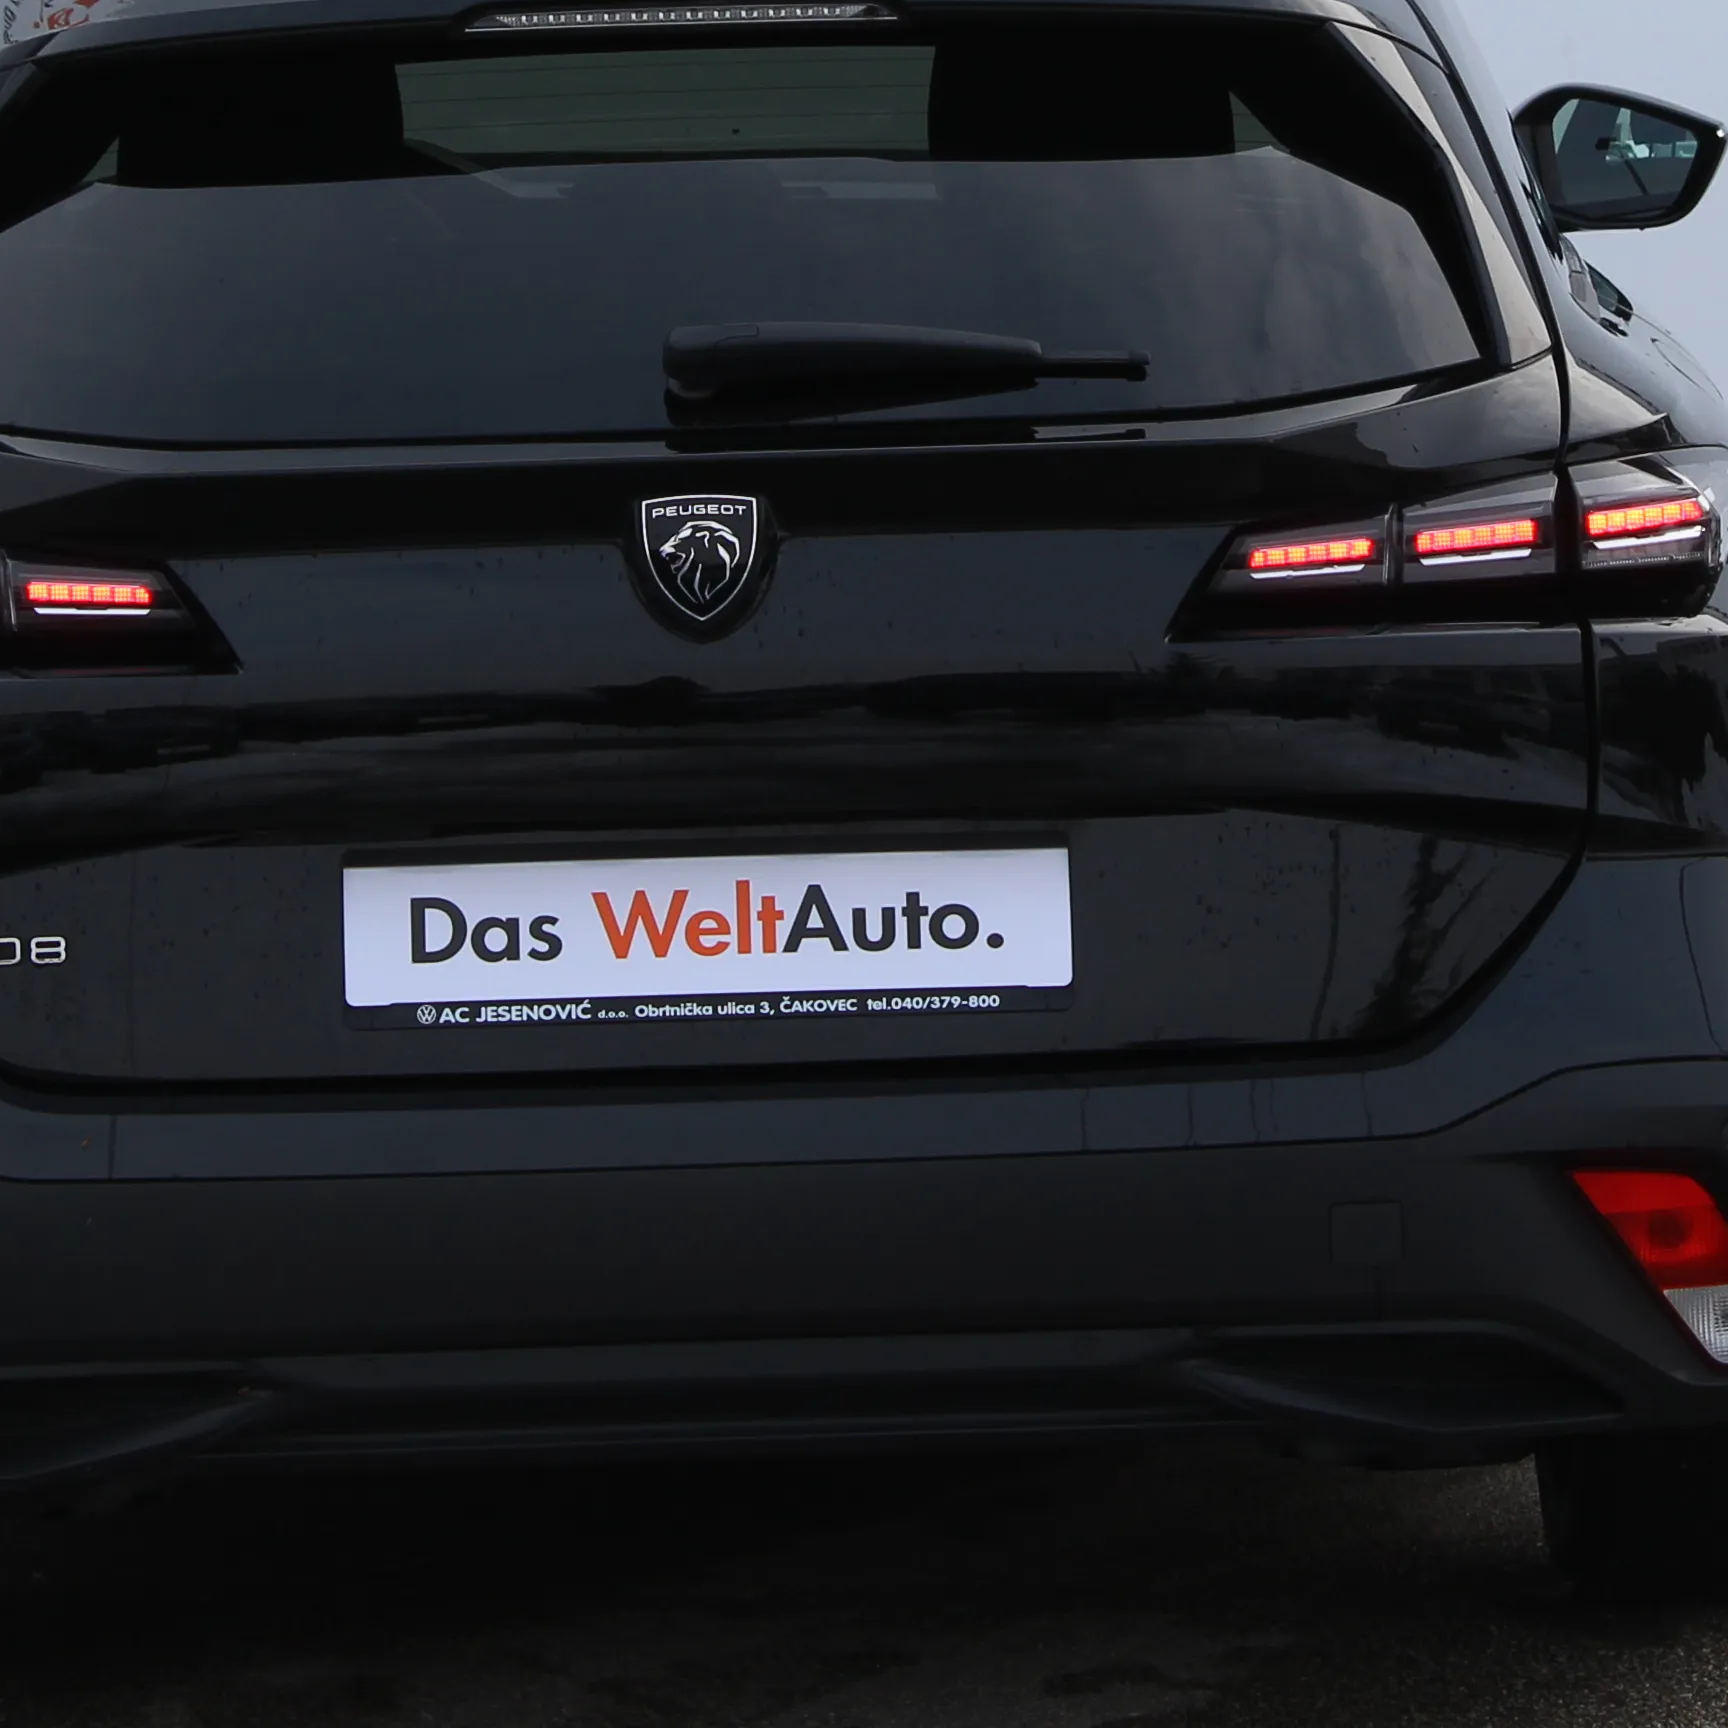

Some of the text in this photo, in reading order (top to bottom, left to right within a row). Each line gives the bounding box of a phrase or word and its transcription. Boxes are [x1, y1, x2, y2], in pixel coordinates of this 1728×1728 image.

[652, 504, 747, 519] PEUGEOT
[410, 880, 1005, 964] Das WeltAuto.
[439, 1007, 470, 1023] AC
[475, 999, 592, 1022] JESENOVIĆ
[598, 1009, 629, 1019] d.o.o.
[635, 1003, 713, 1018] Obrtnička
[718, 1002, 755, 1015] ulica
[760, 1002, 775, 1016] 3,
[780, 996, 858, 1013] ČAKOVEC
[867, 995, 1001, 1011] tel.040/379-800
